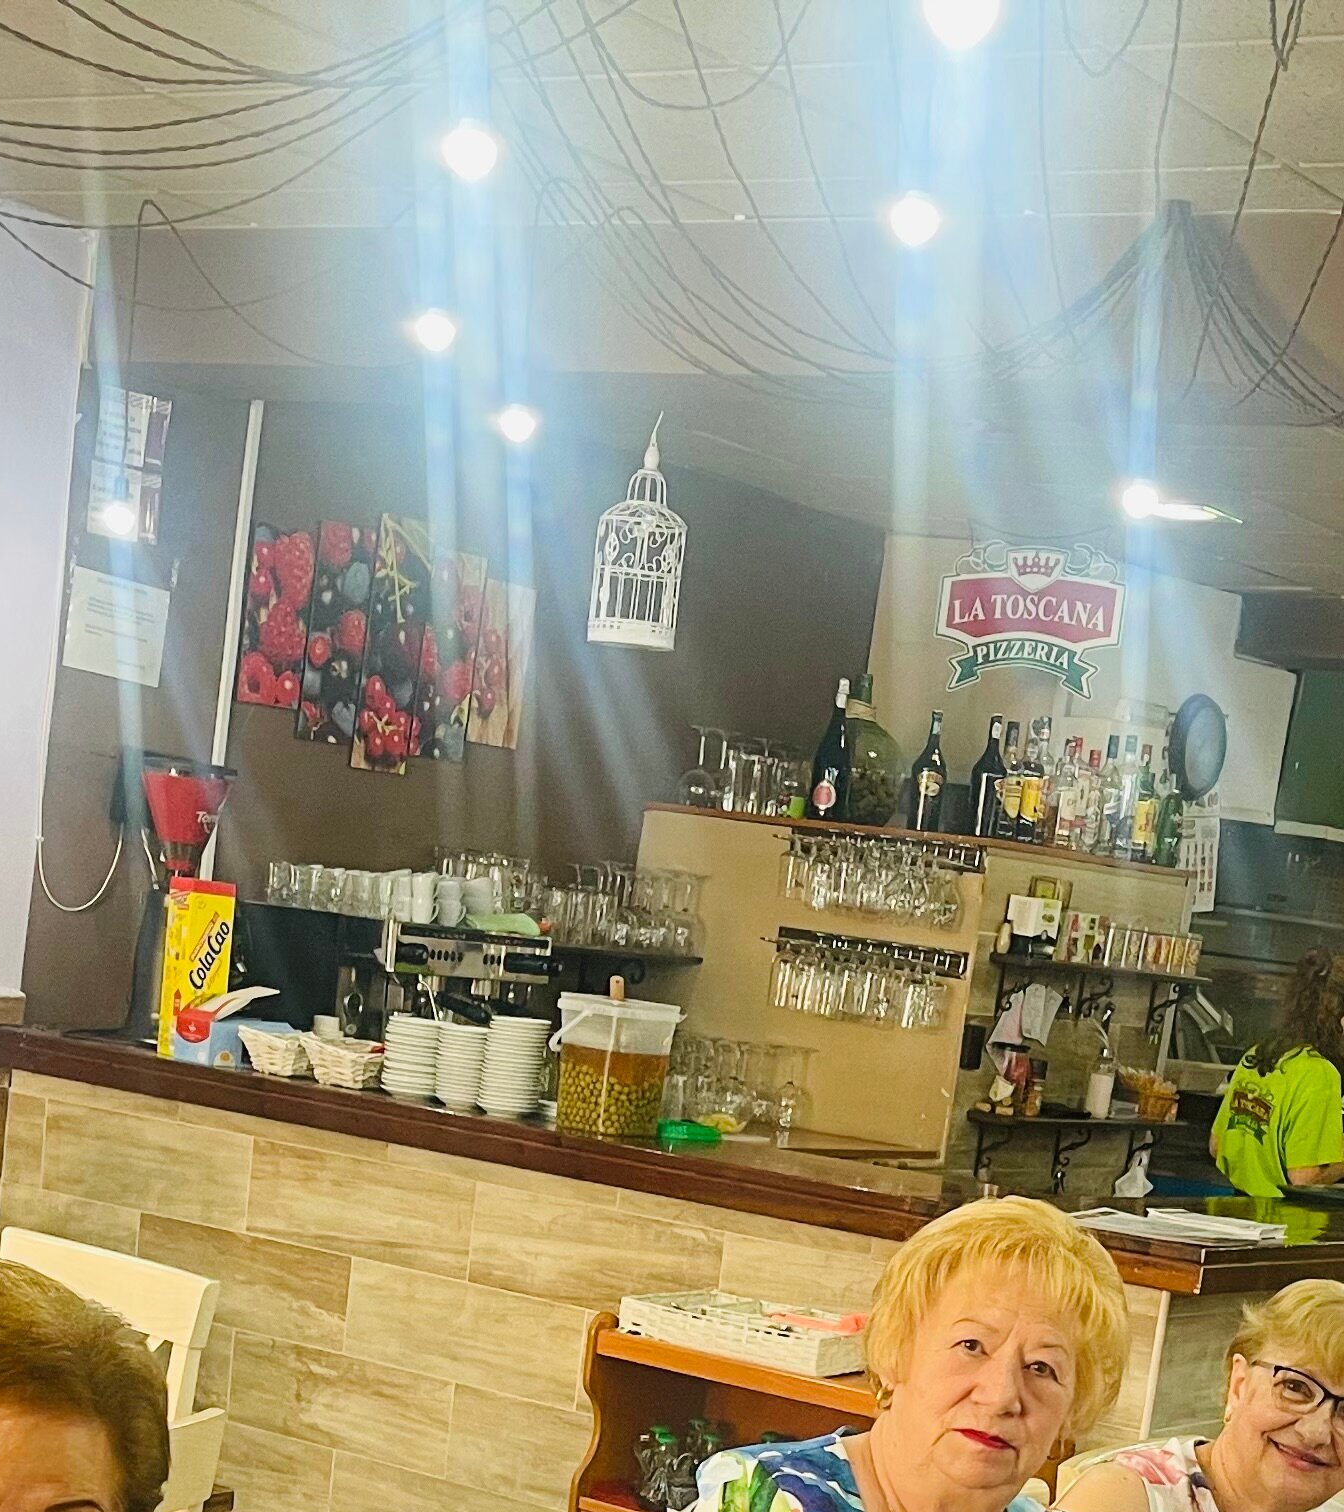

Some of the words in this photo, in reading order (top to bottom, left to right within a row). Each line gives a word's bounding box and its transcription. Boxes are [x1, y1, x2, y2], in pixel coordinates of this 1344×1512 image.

[953, 597, 985, 624] LA
[991, 594, 1106, 632] TOSCANA
[976, 640, 1070, 670] PIZZERIA
[189, 921, 230, 990] ColaCao
